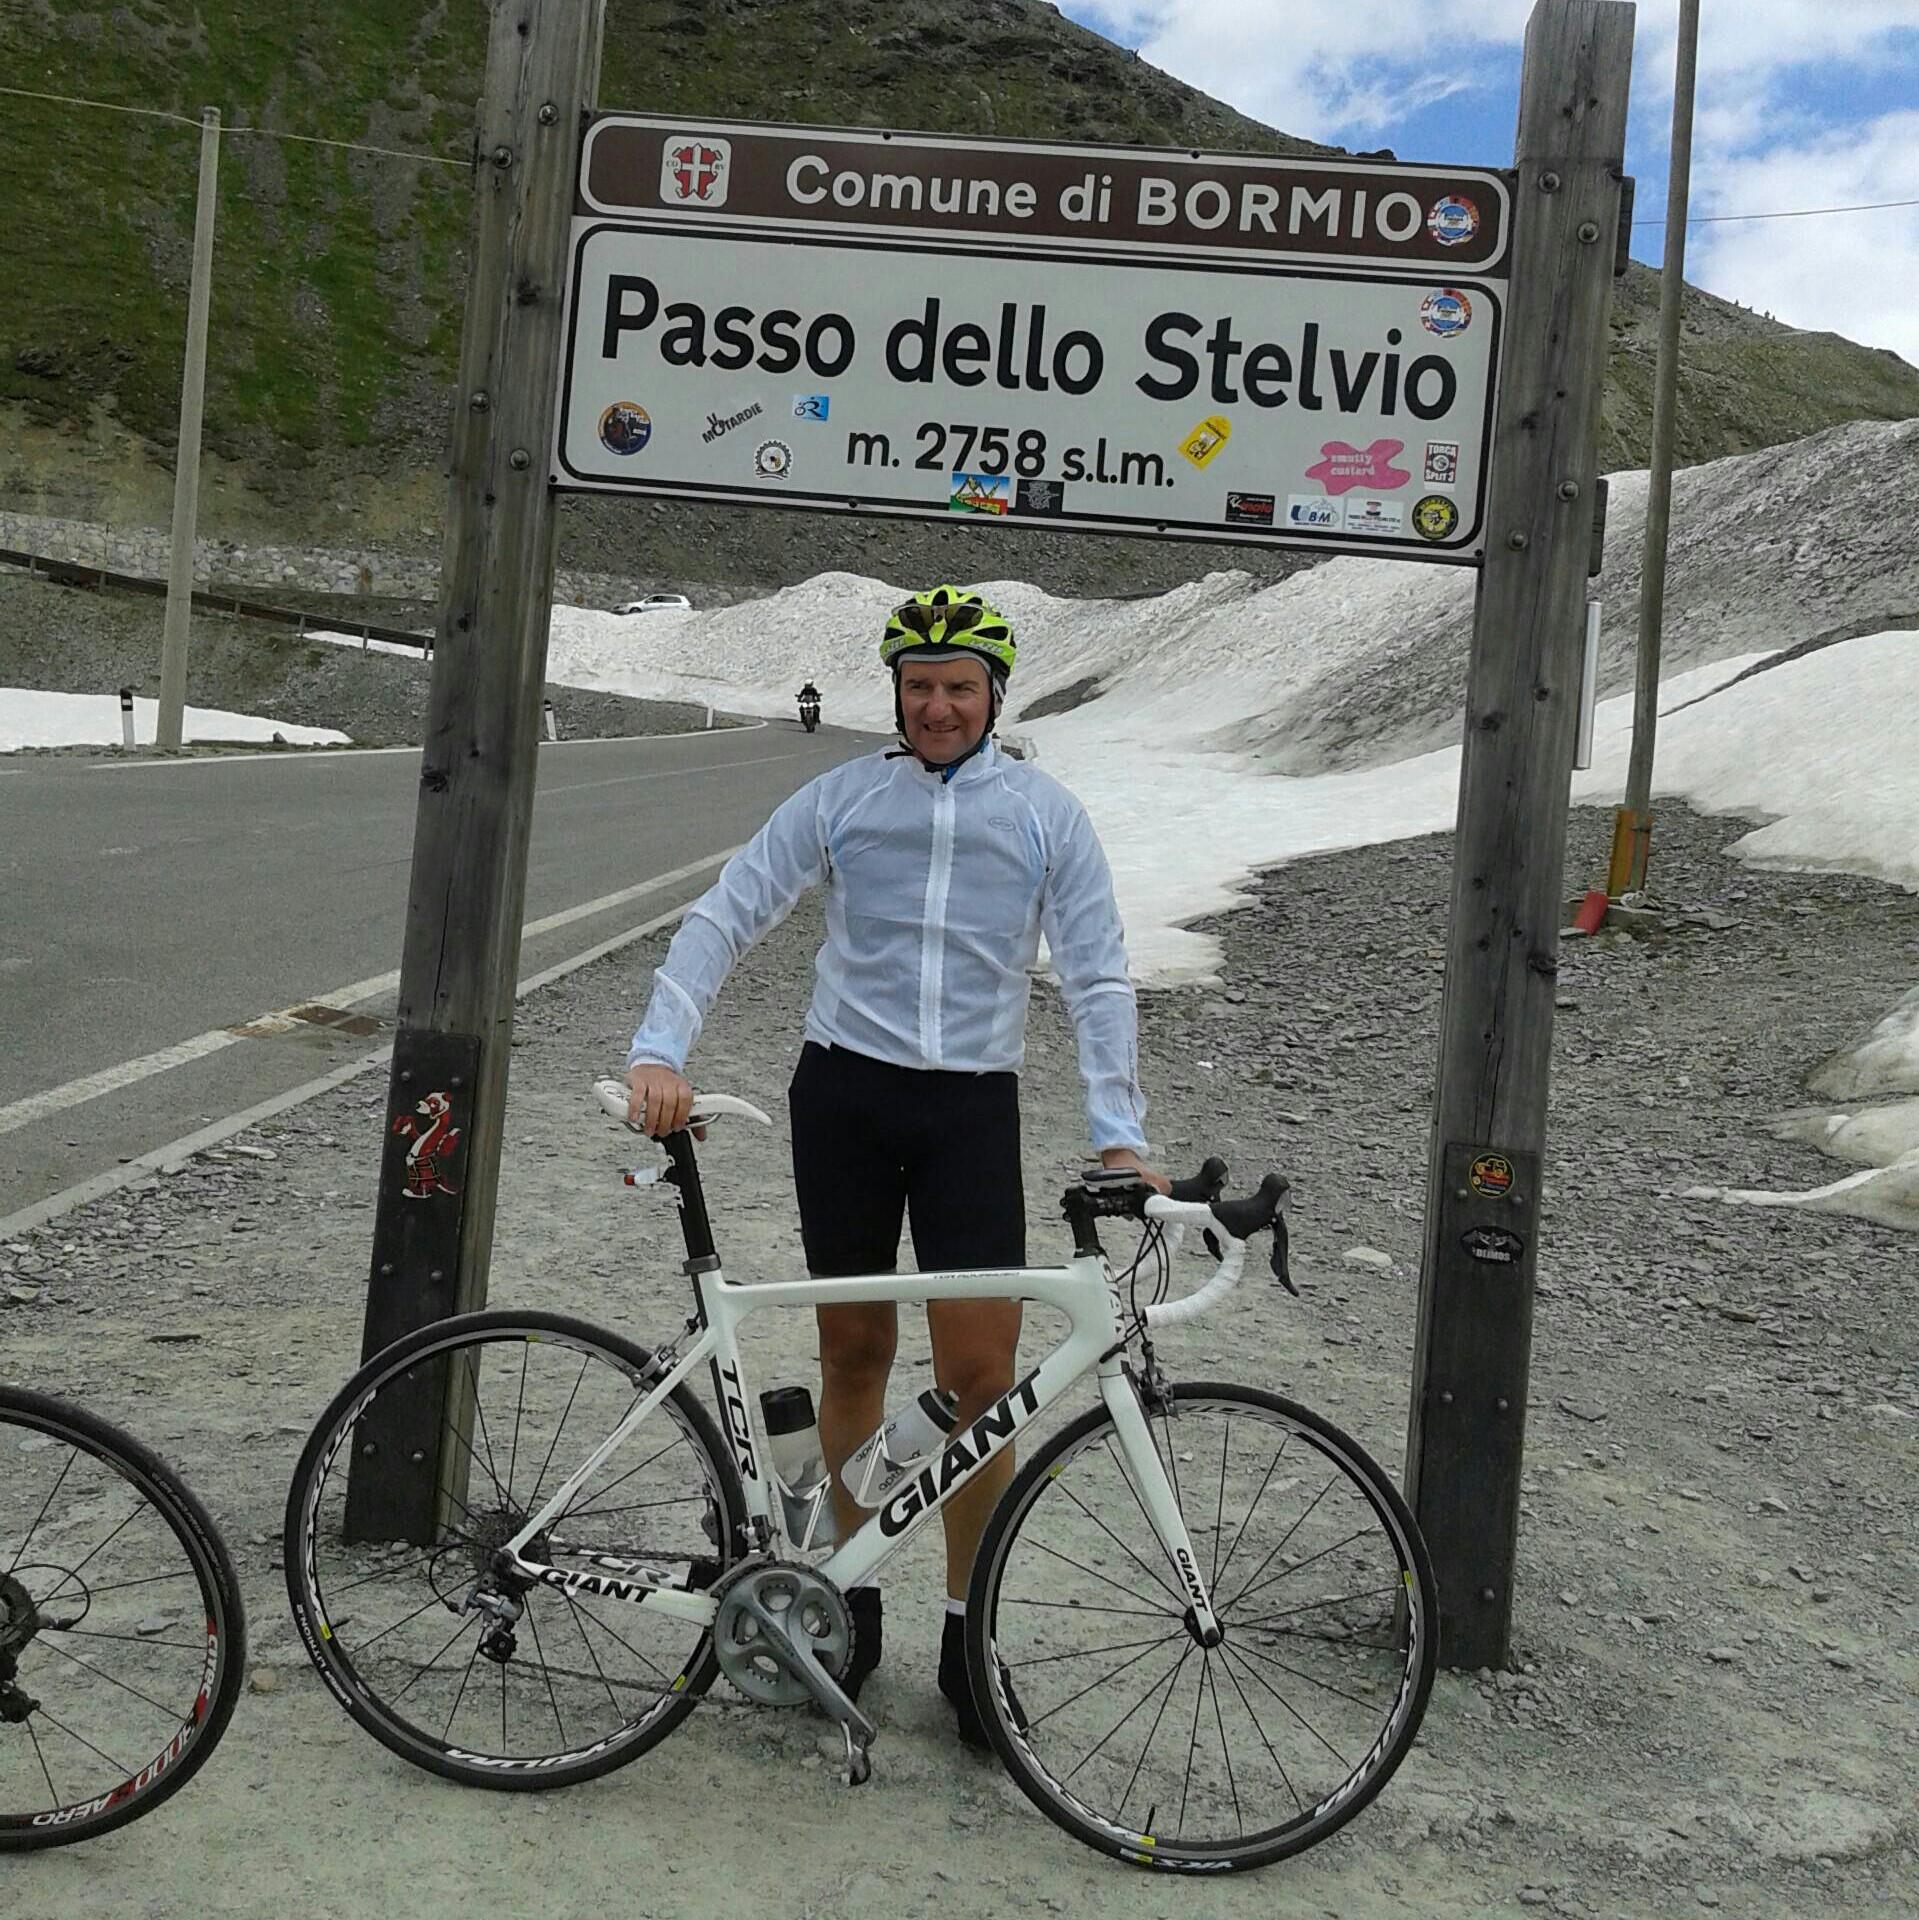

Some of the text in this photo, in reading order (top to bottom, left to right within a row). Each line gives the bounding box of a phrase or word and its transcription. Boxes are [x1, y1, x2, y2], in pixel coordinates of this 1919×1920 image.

[786, 154, 1423, 243] Comune di BORMIO
[602, 274, 1457, 420] Passo dello Stelvio
[846, 422, 1175, 488] m. 2758 s.l.m.
[722, 1359, 758, 1481] TCR
[879, 1367, 1041, 1538] GIANT
[538, 1567, 658, 1604] GIANT
[1176, 1547, 1209, 1612] GIANT
[32, 1793, 114, 1827] AERO
